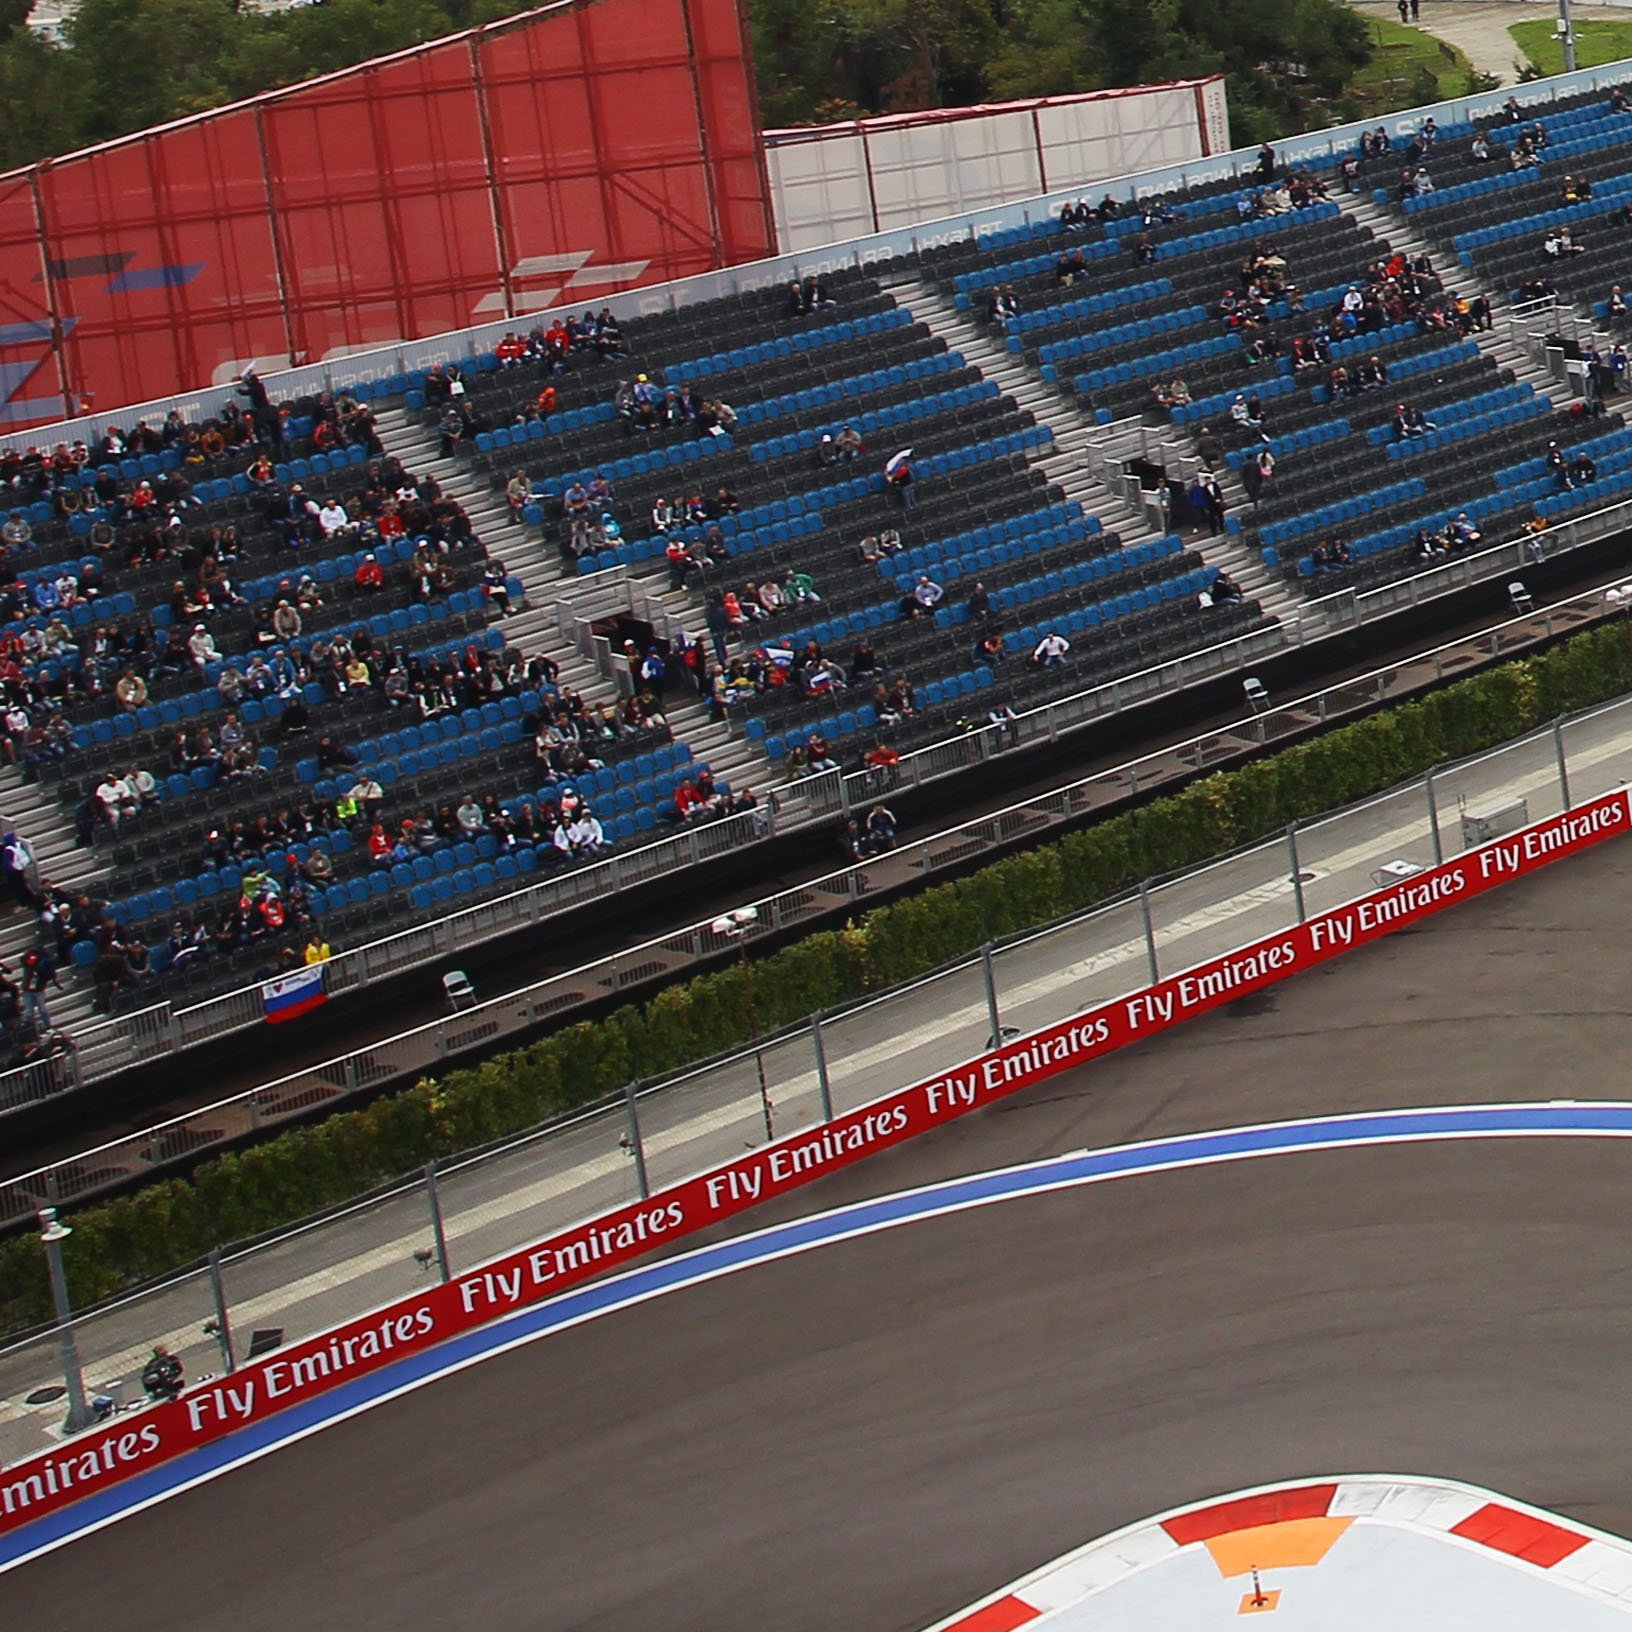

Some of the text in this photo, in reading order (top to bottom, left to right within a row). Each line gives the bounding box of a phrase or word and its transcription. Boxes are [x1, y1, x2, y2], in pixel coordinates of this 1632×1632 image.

[1479, 801, 1623, 878] Fly Emirates
[1309, 869, 1465, 951] Fly Emirates
[1126, 941, 1295, 1029] Fly Emirates
[925, 1018, 1109, 1114] Fly Emirates
[705, 1105, 907, 1209] Fly Emirates
[459, 1201, 683, 1313] Fly Emirates
[186, 1307, 433, 1431] Fly Emirates
[0, 1424, 160, 1518] mirates
